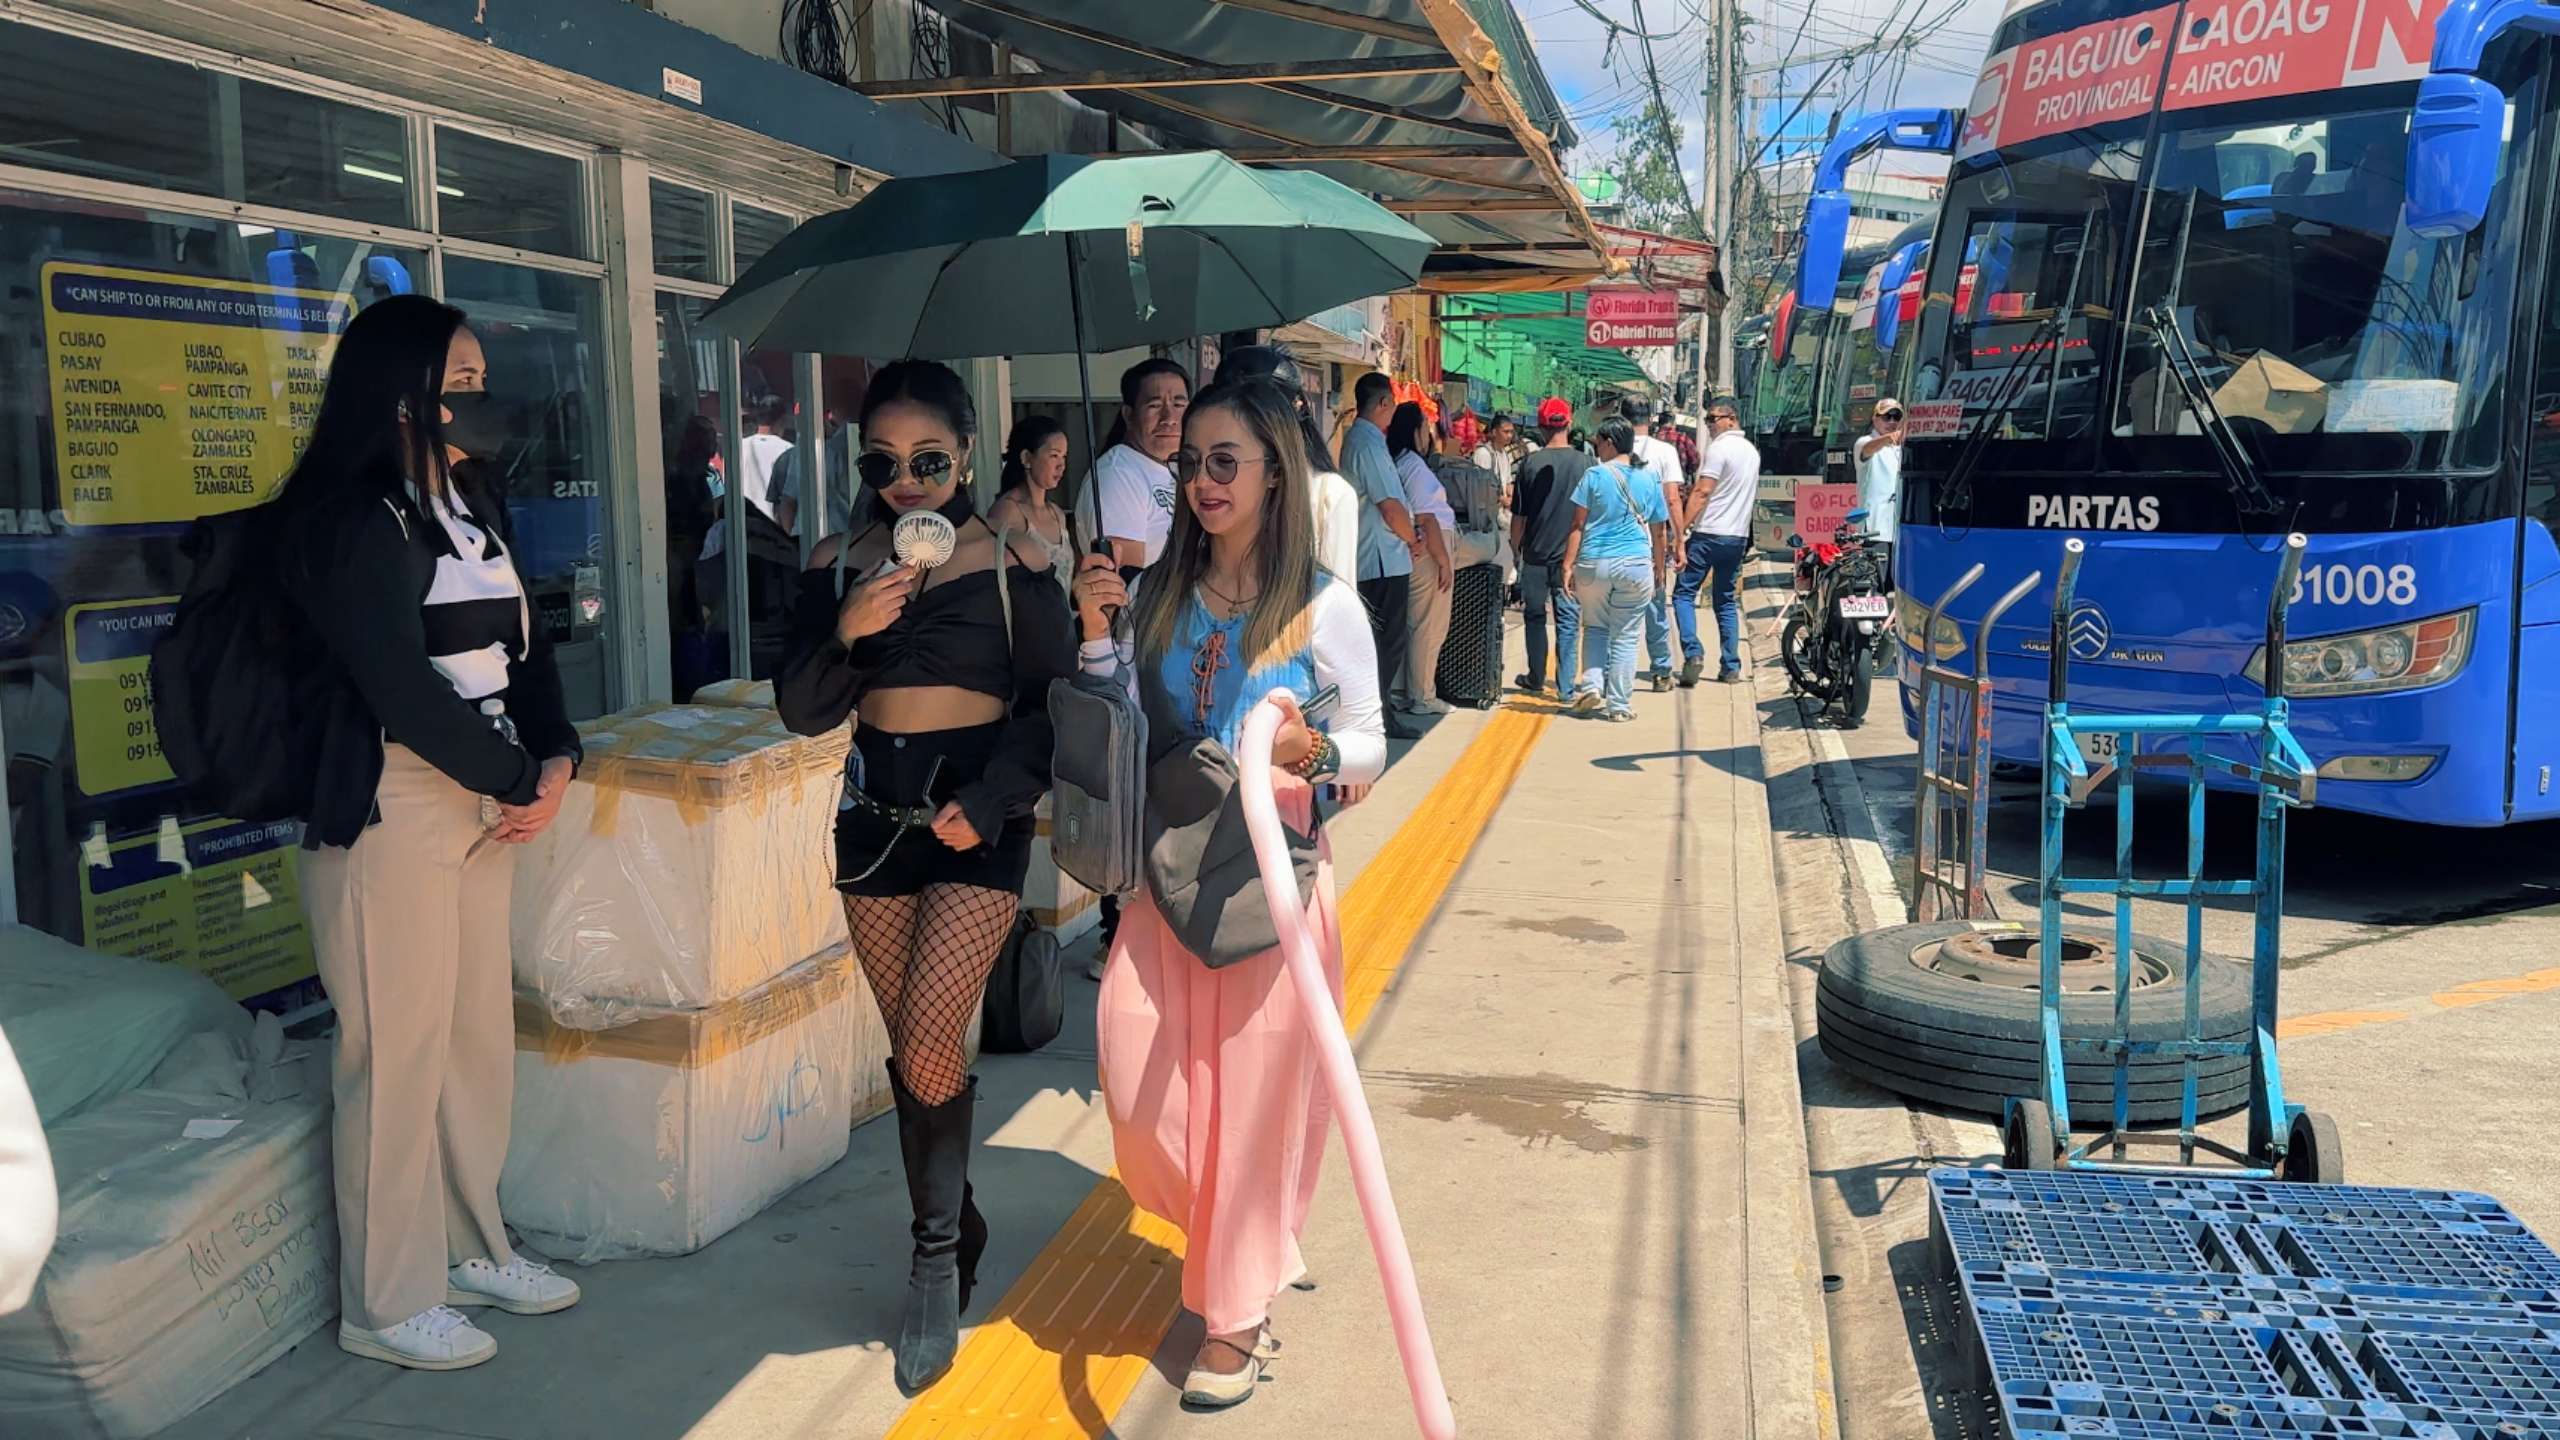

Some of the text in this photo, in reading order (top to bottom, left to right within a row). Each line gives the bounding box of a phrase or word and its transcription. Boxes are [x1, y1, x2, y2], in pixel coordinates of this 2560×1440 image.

[2178, 0, 2329, 55] LAOAG
[2034, 73, 2153, 127] PROVINCIAL
[2181, 52, 2285, 96] AIRCON
[100, 289, 126, 305] SHIP
[126, 292, 143, 305] TO
[145, 294, 161, 307] OR
[163, 295, 194, 310] FROM
[195, 298, 217, 312] ANY
[219, 301, 233, 314] OF
[234, 302, 256, 316] OUR
[256, 304, 309, 321] TERMINALS
[1614, 300, 1647, 313] Florida
[1647, 300, 1675, 313] Trans
[59, 331, 106, 348] CUBAO
[1611, 325, 1647, 339] Gabriel
[1647, 324, 1675, 339] Trans
[60, 354, 102, 371] PASAY
[185, 359, 249, 376] PAMPANGA
[63, 378, 122, 395] AVENIDA
[187, 383, 252, 399] CAVITE CITY
[65, 402, 167, 421] SAN FERNANDO,
[1940, 402, 1962, 417] FARE
[66, 418, 141, 434] PAMPANGA
[191, 428, 257, 444] OLONGAPO,
[68, 442, 119, 457] BAGUIO
[192, 444, 253, 459] ZAMBALES
[70, 464, 112, 480] CLARK
[193, 465, 215, 480] STA.
[73, 487, 113, 502] BALER
[195, 480, 255, 495] ZAMBALES
[2027, 494, 2160, 532] PARTAS
[130, 615, 153, 629] CAN
[154, 612, 177, 626] INQ
[2111, 647, 2165, 662] DRAGON
[119, 672, 150, 690] 091
[123, 696, 152, 713] 091
[127, 719, 154, 738] 091
[264, 822, 294, 842] ITEMS
